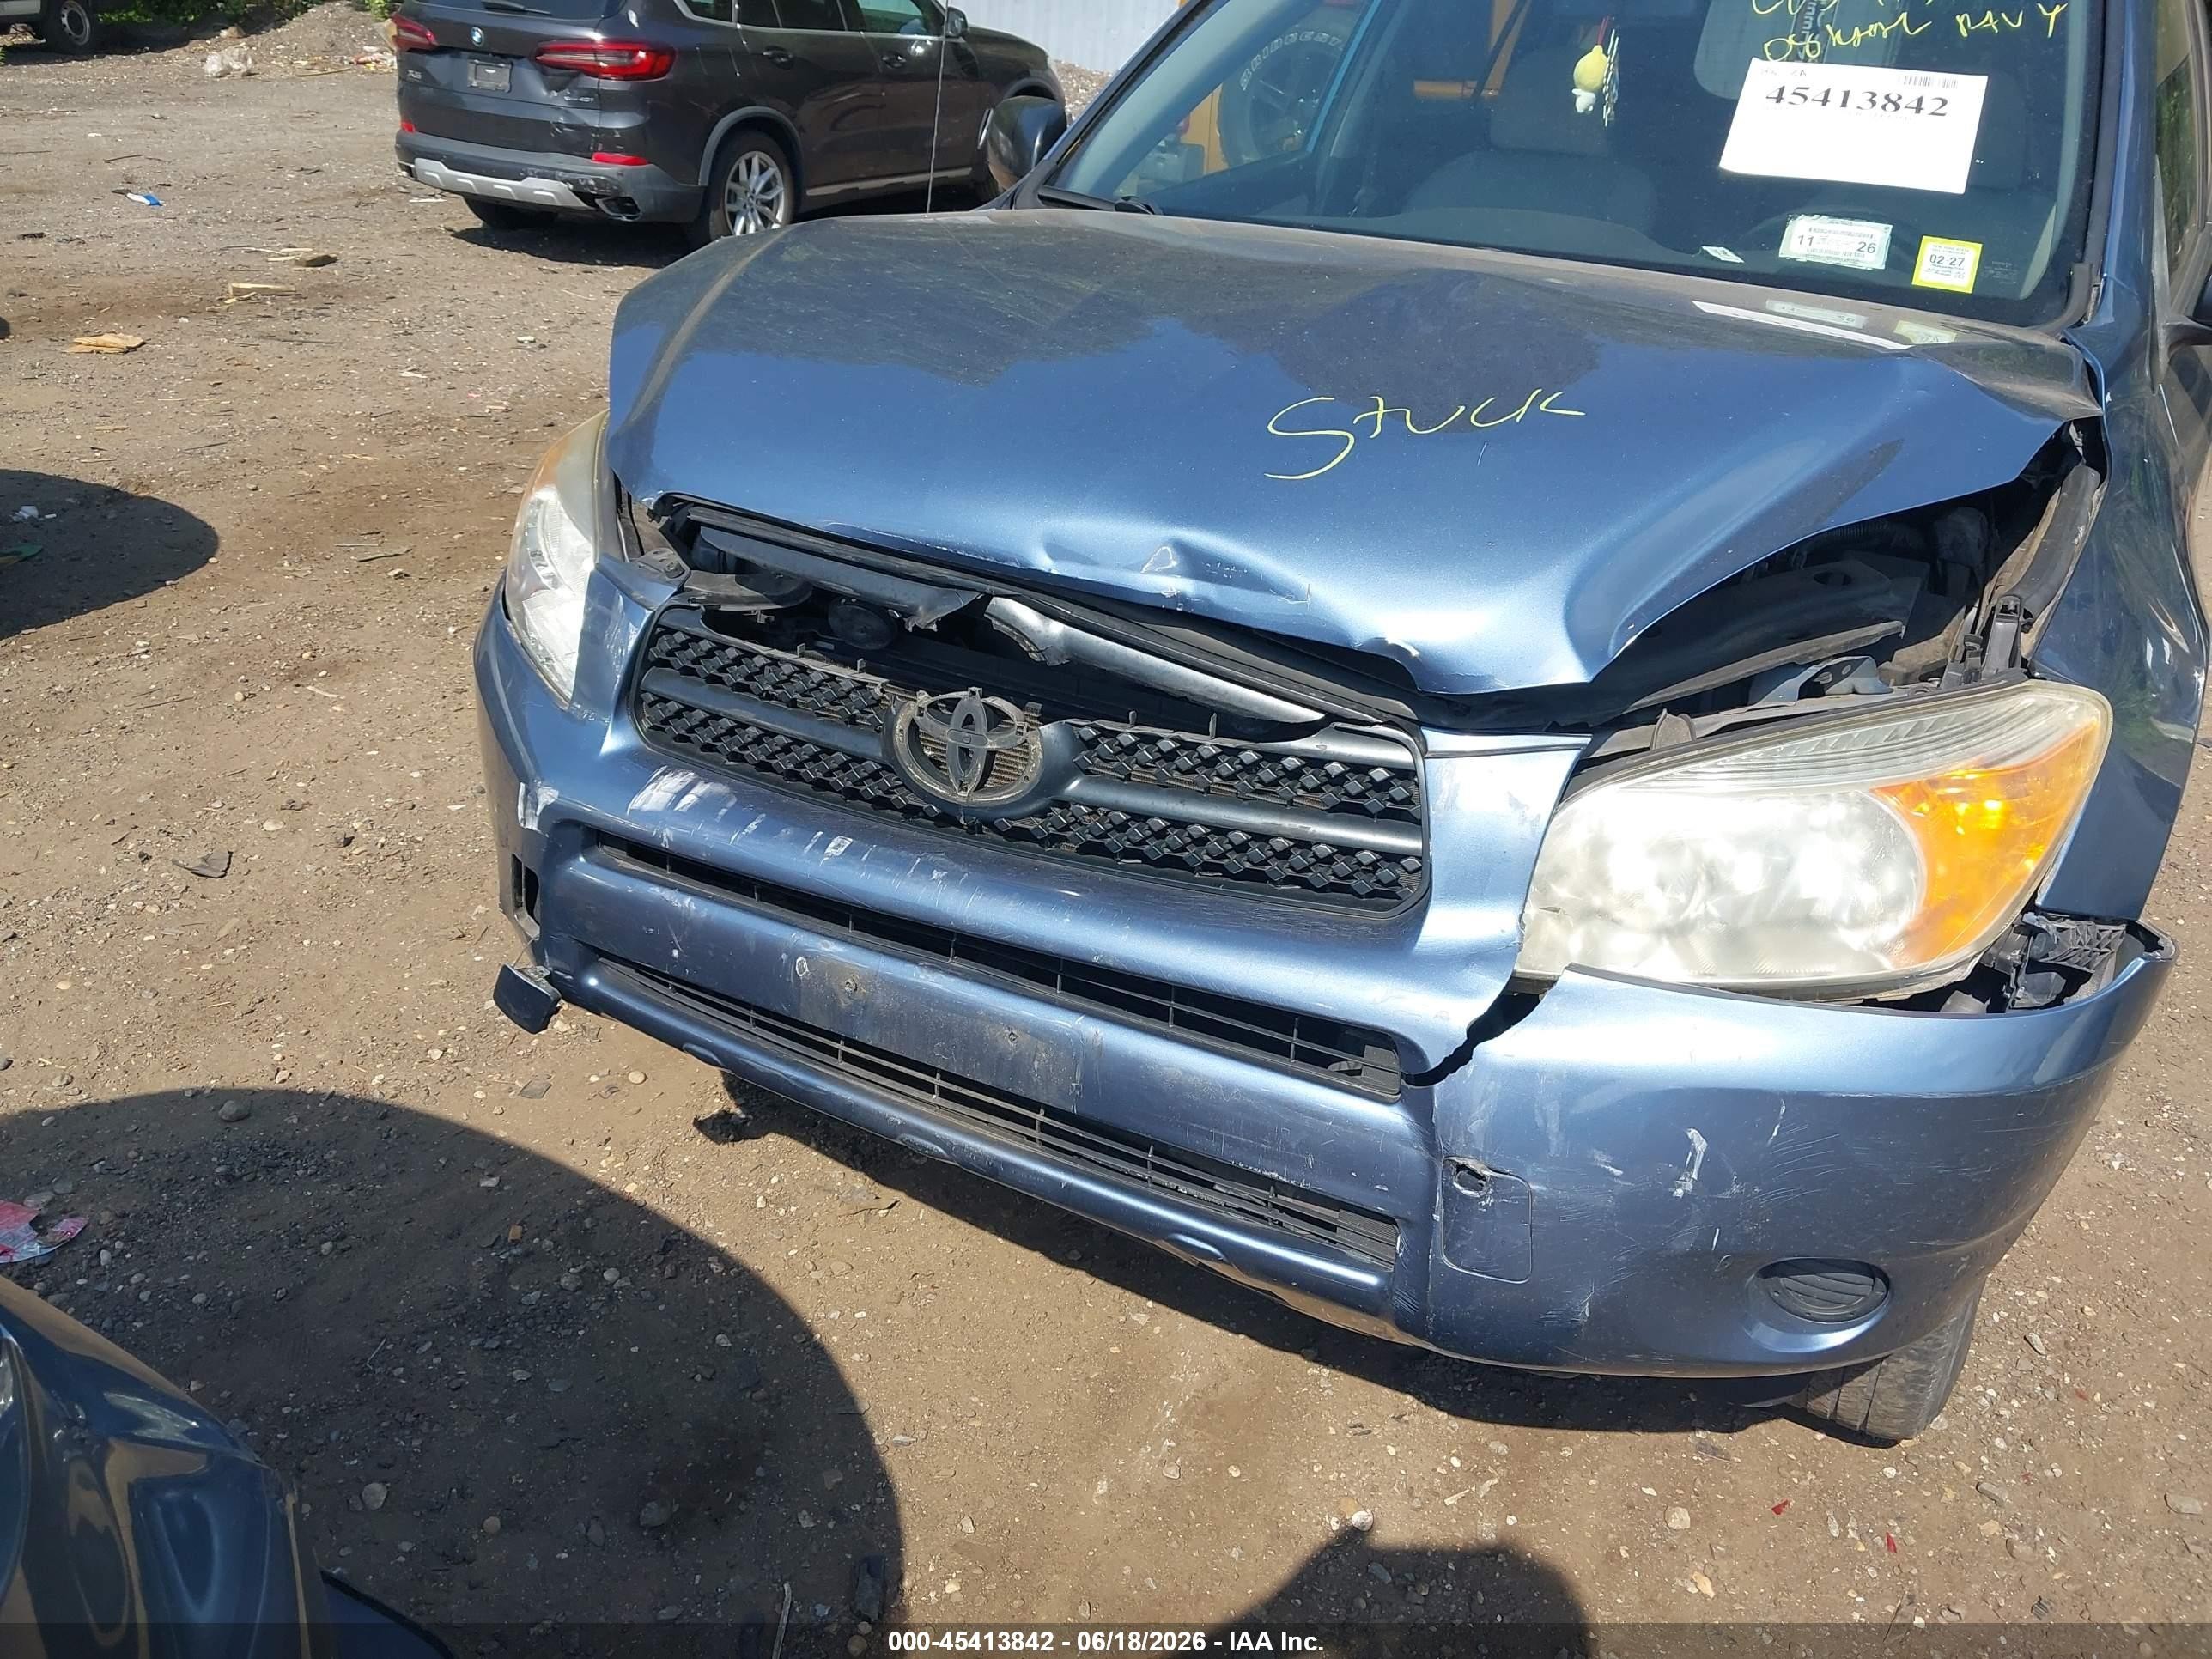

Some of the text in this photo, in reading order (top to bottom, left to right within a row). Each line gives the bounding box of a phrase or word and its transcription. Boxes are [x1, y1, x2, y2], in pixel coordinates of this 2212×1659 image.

[1765, 85, 1948, 117] 45413842
[1798, 234, 1814, 246] 11
[1856, 241, 1876, 253] 26
